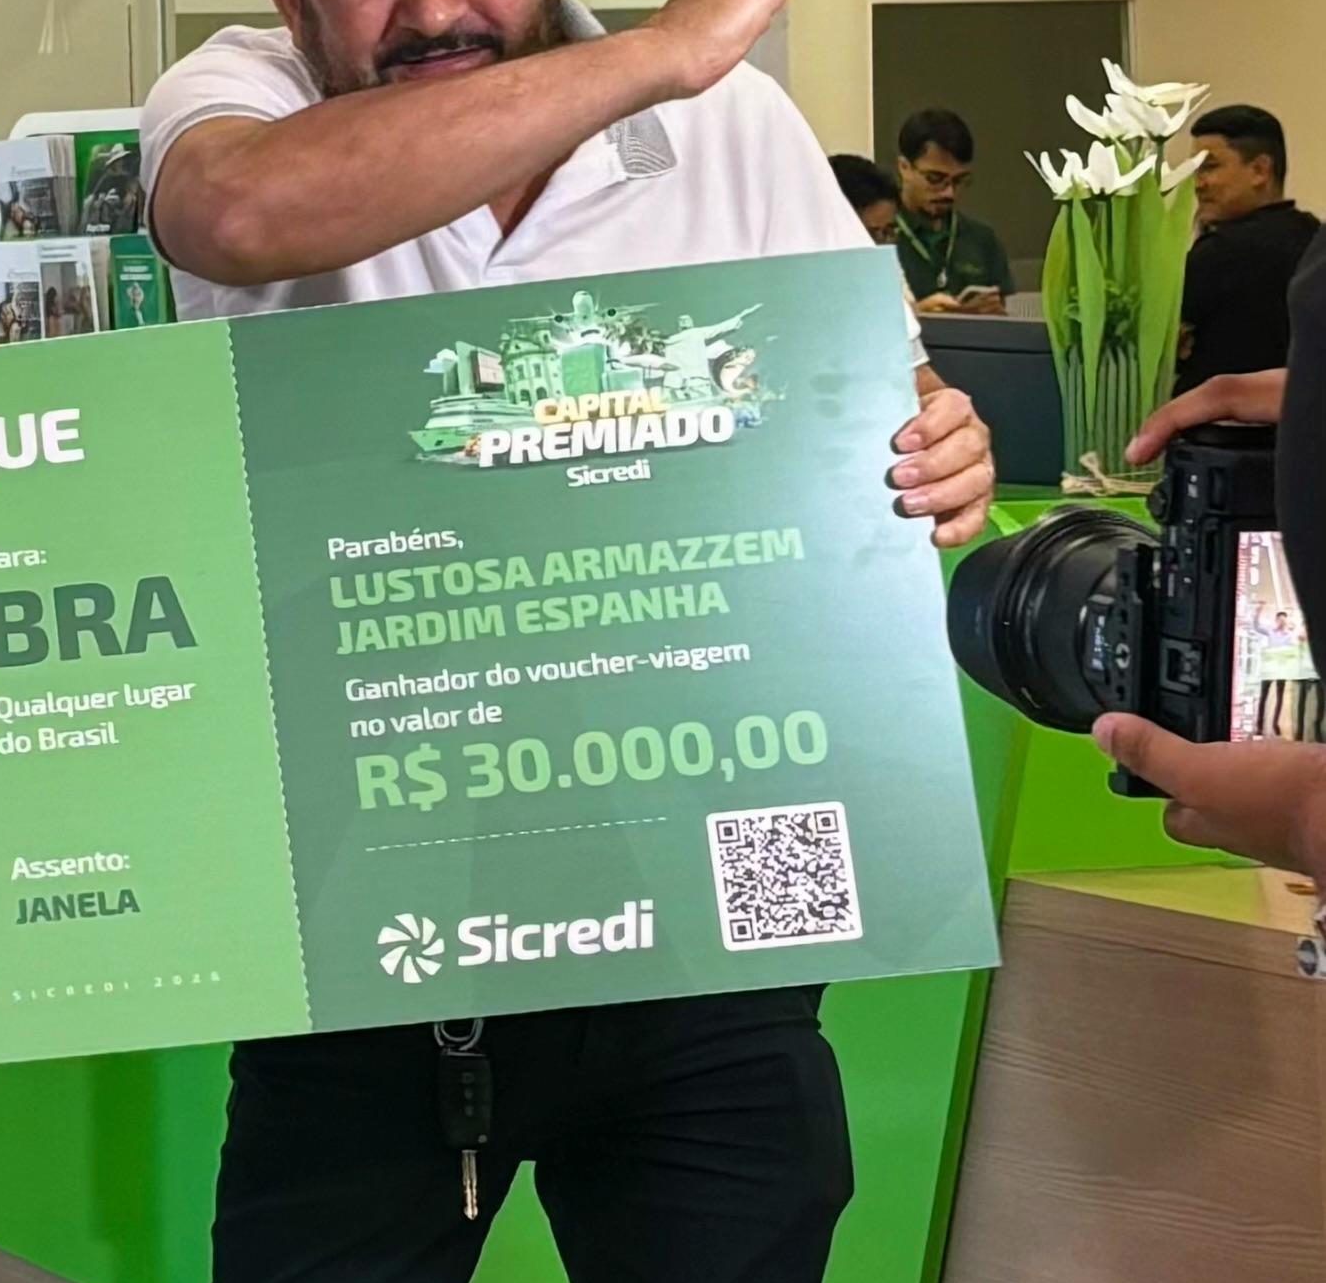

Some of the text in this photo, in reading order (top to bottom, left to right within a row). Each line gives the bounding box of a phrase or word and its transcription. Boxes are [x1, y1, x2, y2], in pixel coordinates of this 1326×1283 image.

[533, 386, 672, 425] CAPITAL
[478, 406, 735, 468] PREMIADO
[566, 459, 652, 487] Sicredi
[327, 527, 465, 561] Parabéns,
[329, 526, 805, 609] LUSTOSA ARMAZZEM
[336, 581, 731, 655] JARDIM ESPANHA
[345, 642, 751, 703] Ganhador do voucher-viagem
[123, 682, 197, 709] lugar
[38, 721, 119, 751] Brasil
[350, 701, 503, 738] no valor de
[355, 709, 829, 812] R$ 30.000,00
[11, 852, 131, 881] Assento:
[15, 889, 141, 925] JANELA
[457, 898, 654, 966] Sicredi
